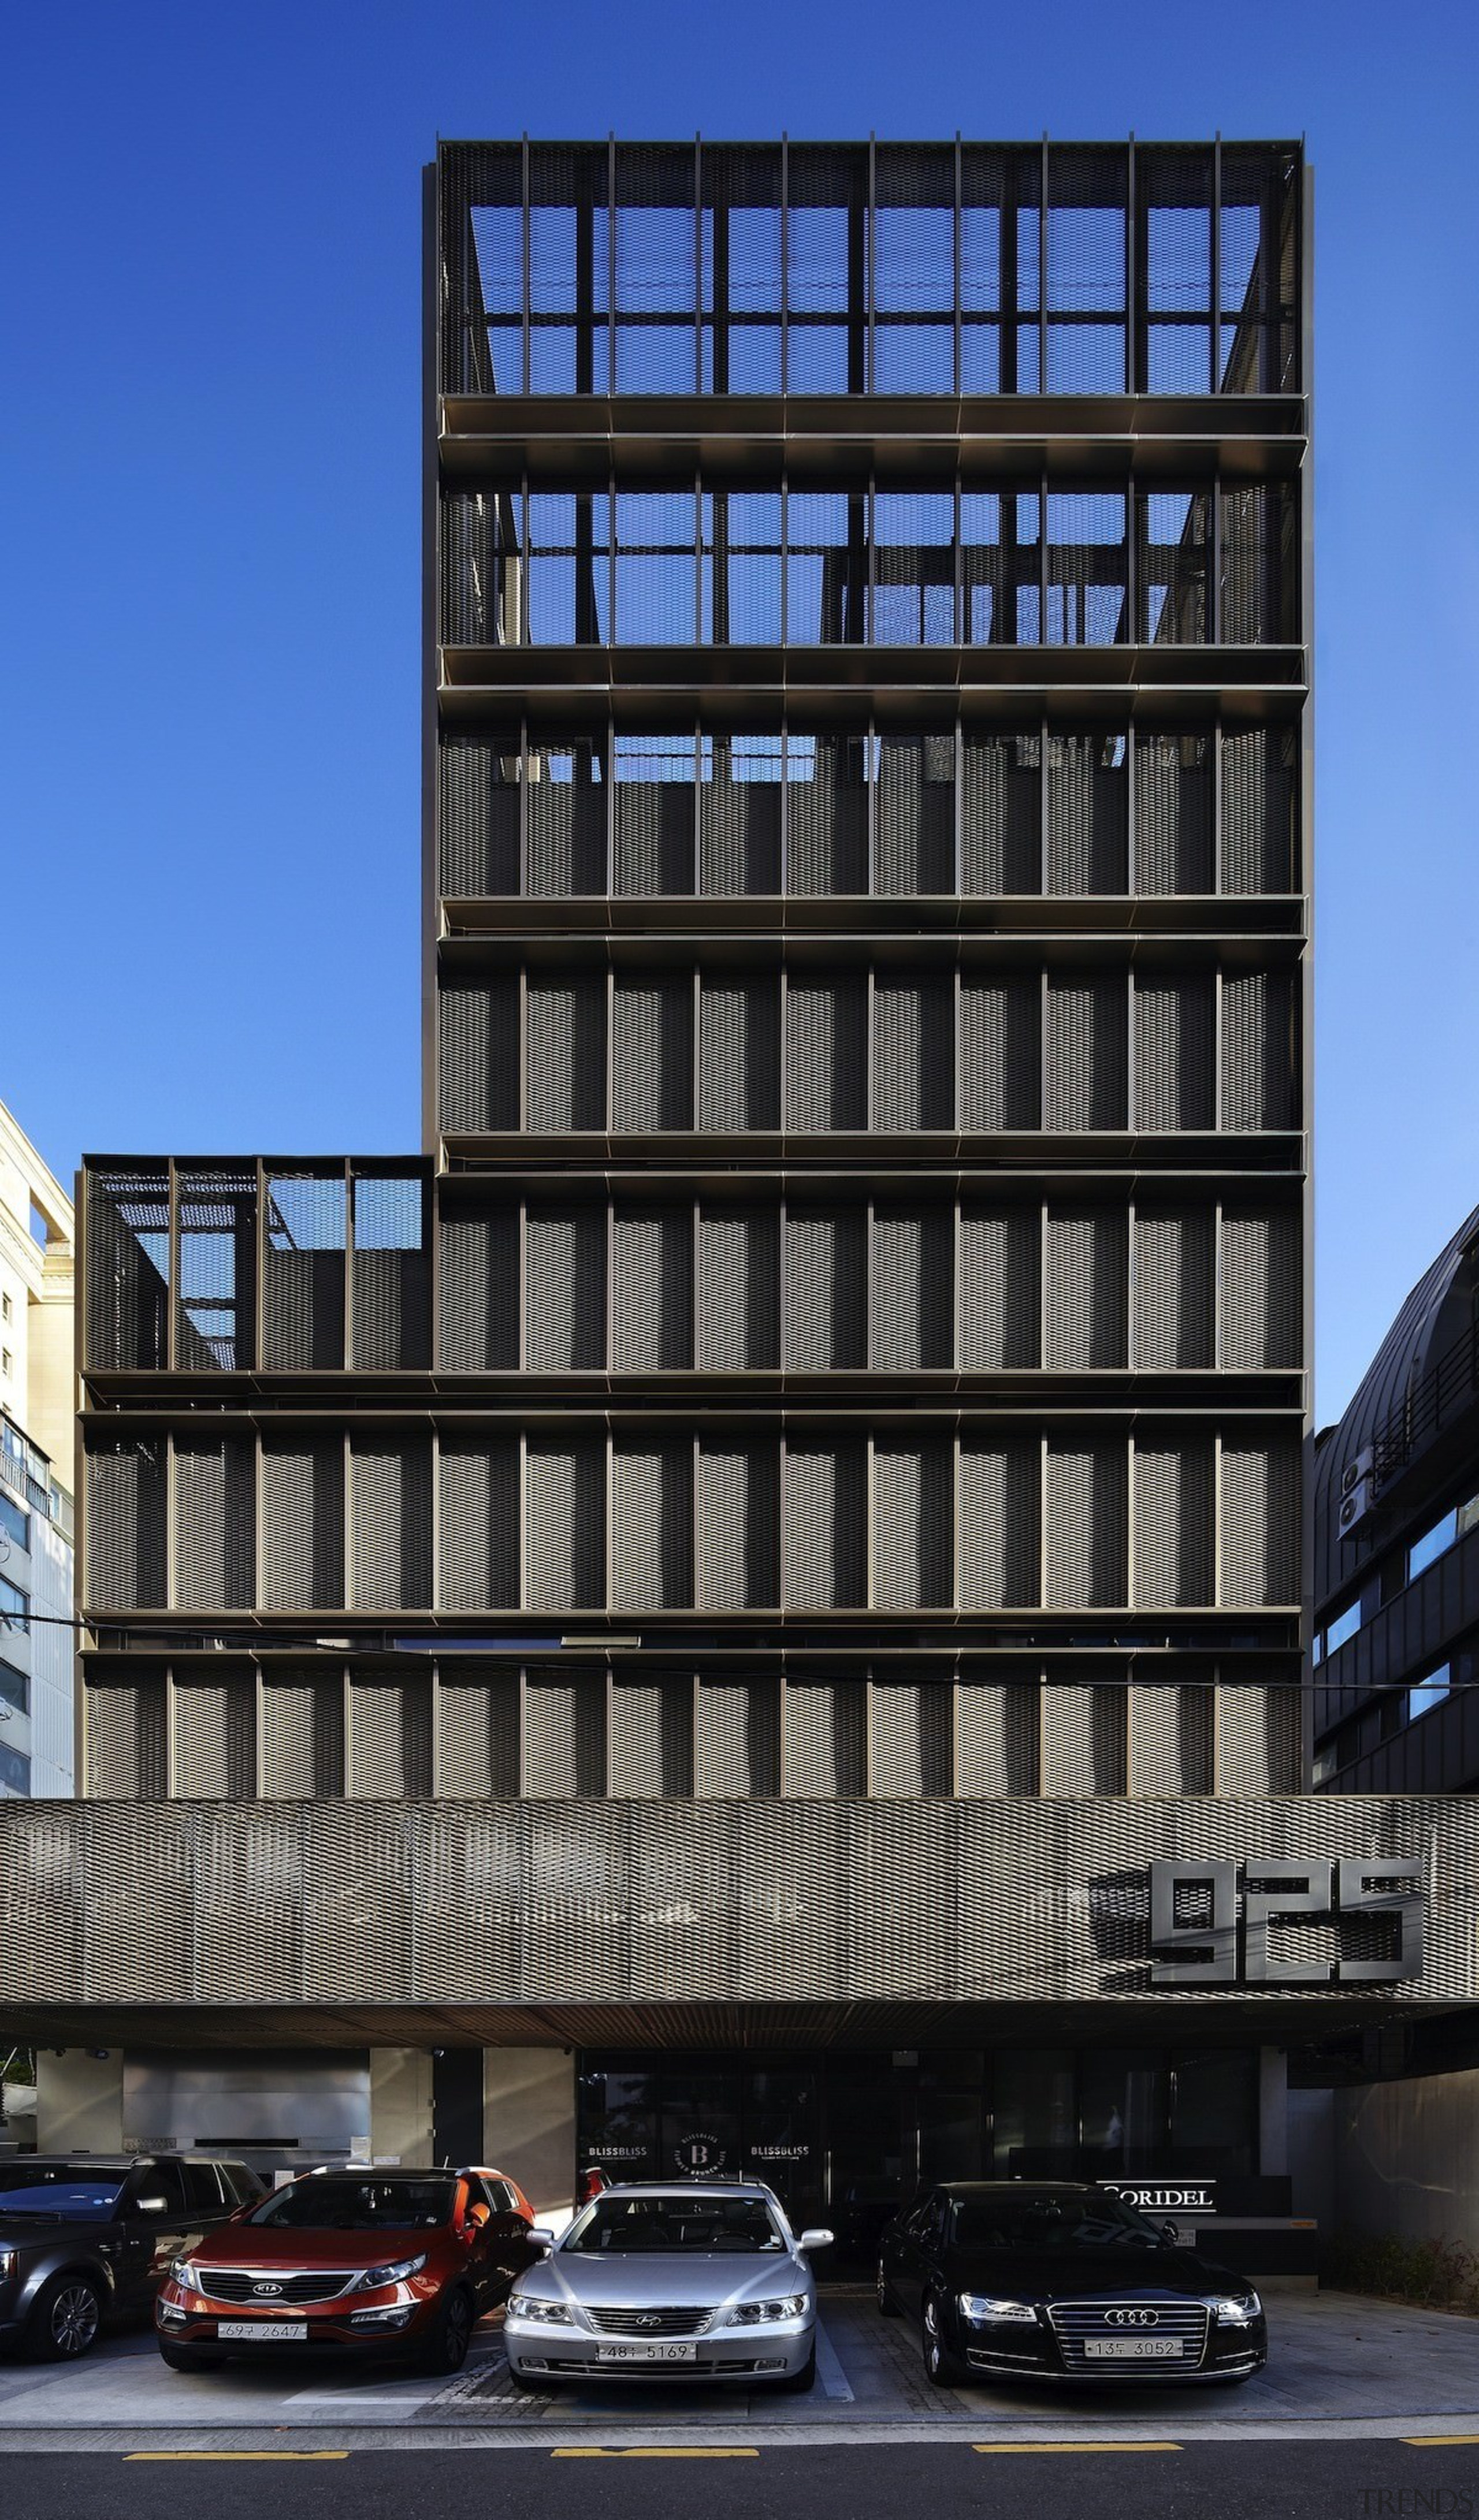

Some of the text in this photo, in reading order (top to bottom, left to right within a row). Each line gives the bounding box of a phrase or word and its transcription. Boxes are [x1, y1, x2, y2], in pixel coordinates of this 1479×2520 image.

[1150, 1859, 1423, 1981] 925
[588, 2147, 647, 2156] BLISSBLISS
[691, 2145, 708, 2164] B
[750, 2146, 809, 2156] BLISSBLISS
[226, 2325, 299, 2337] 69구 2647
[647, 2346, 687, 2358] 5169
[1134, 2342, 1174, 2355] 3052
